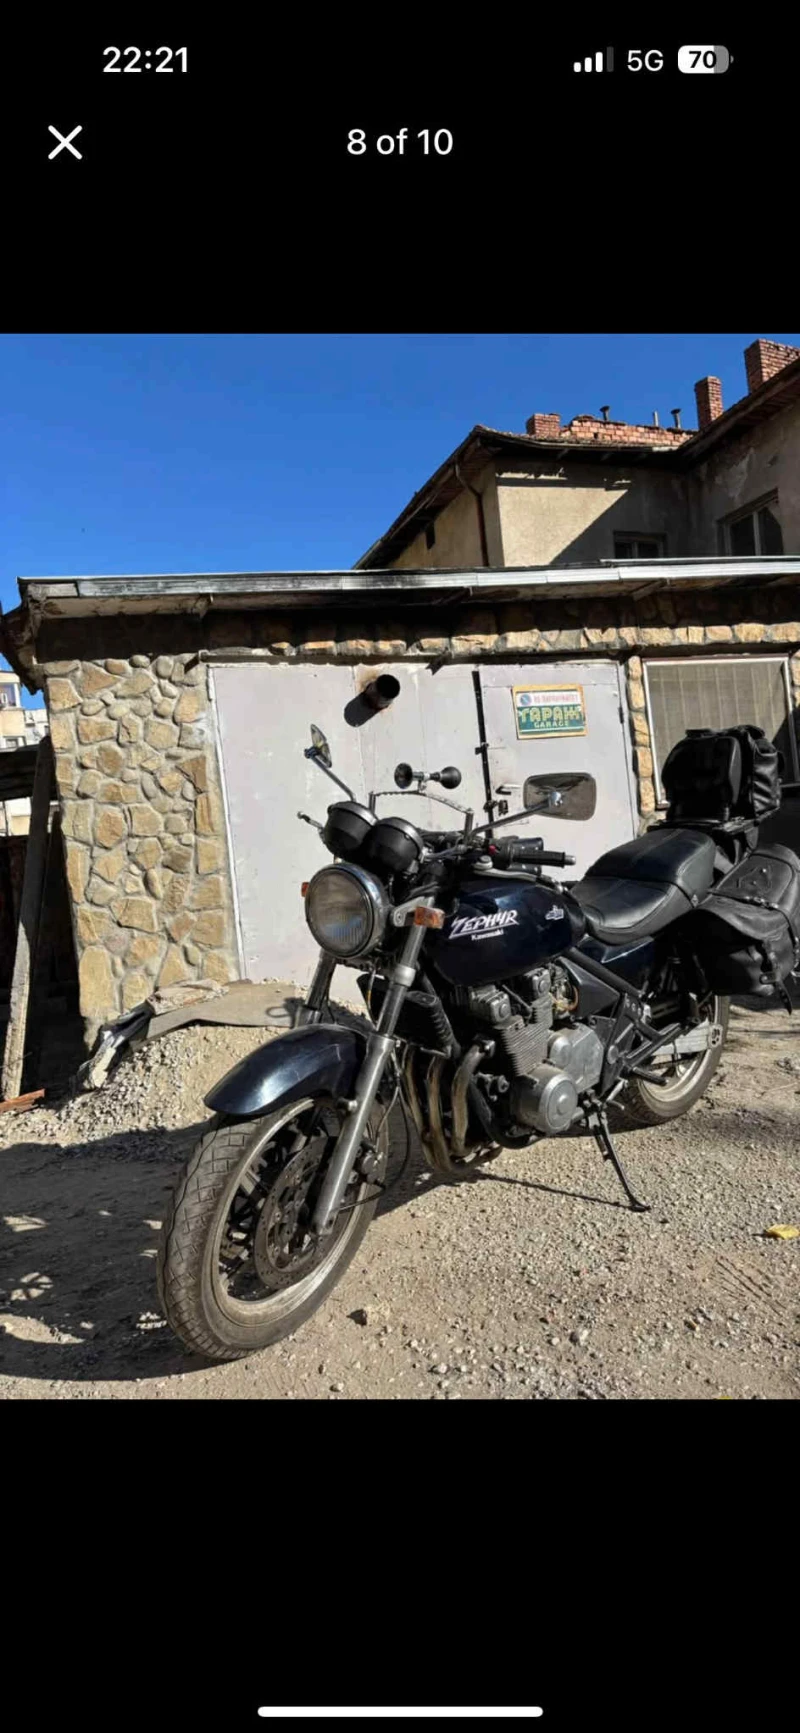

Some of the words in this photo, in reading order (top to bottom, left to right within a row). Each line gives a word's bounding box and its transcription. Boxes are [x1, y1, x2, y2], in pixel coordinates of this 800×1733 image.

[534, 720, 569, 728] GARAGE
[448, 909, 520, 940] ZEPHYR
[471, 929, 504, 940] Kawasaki
